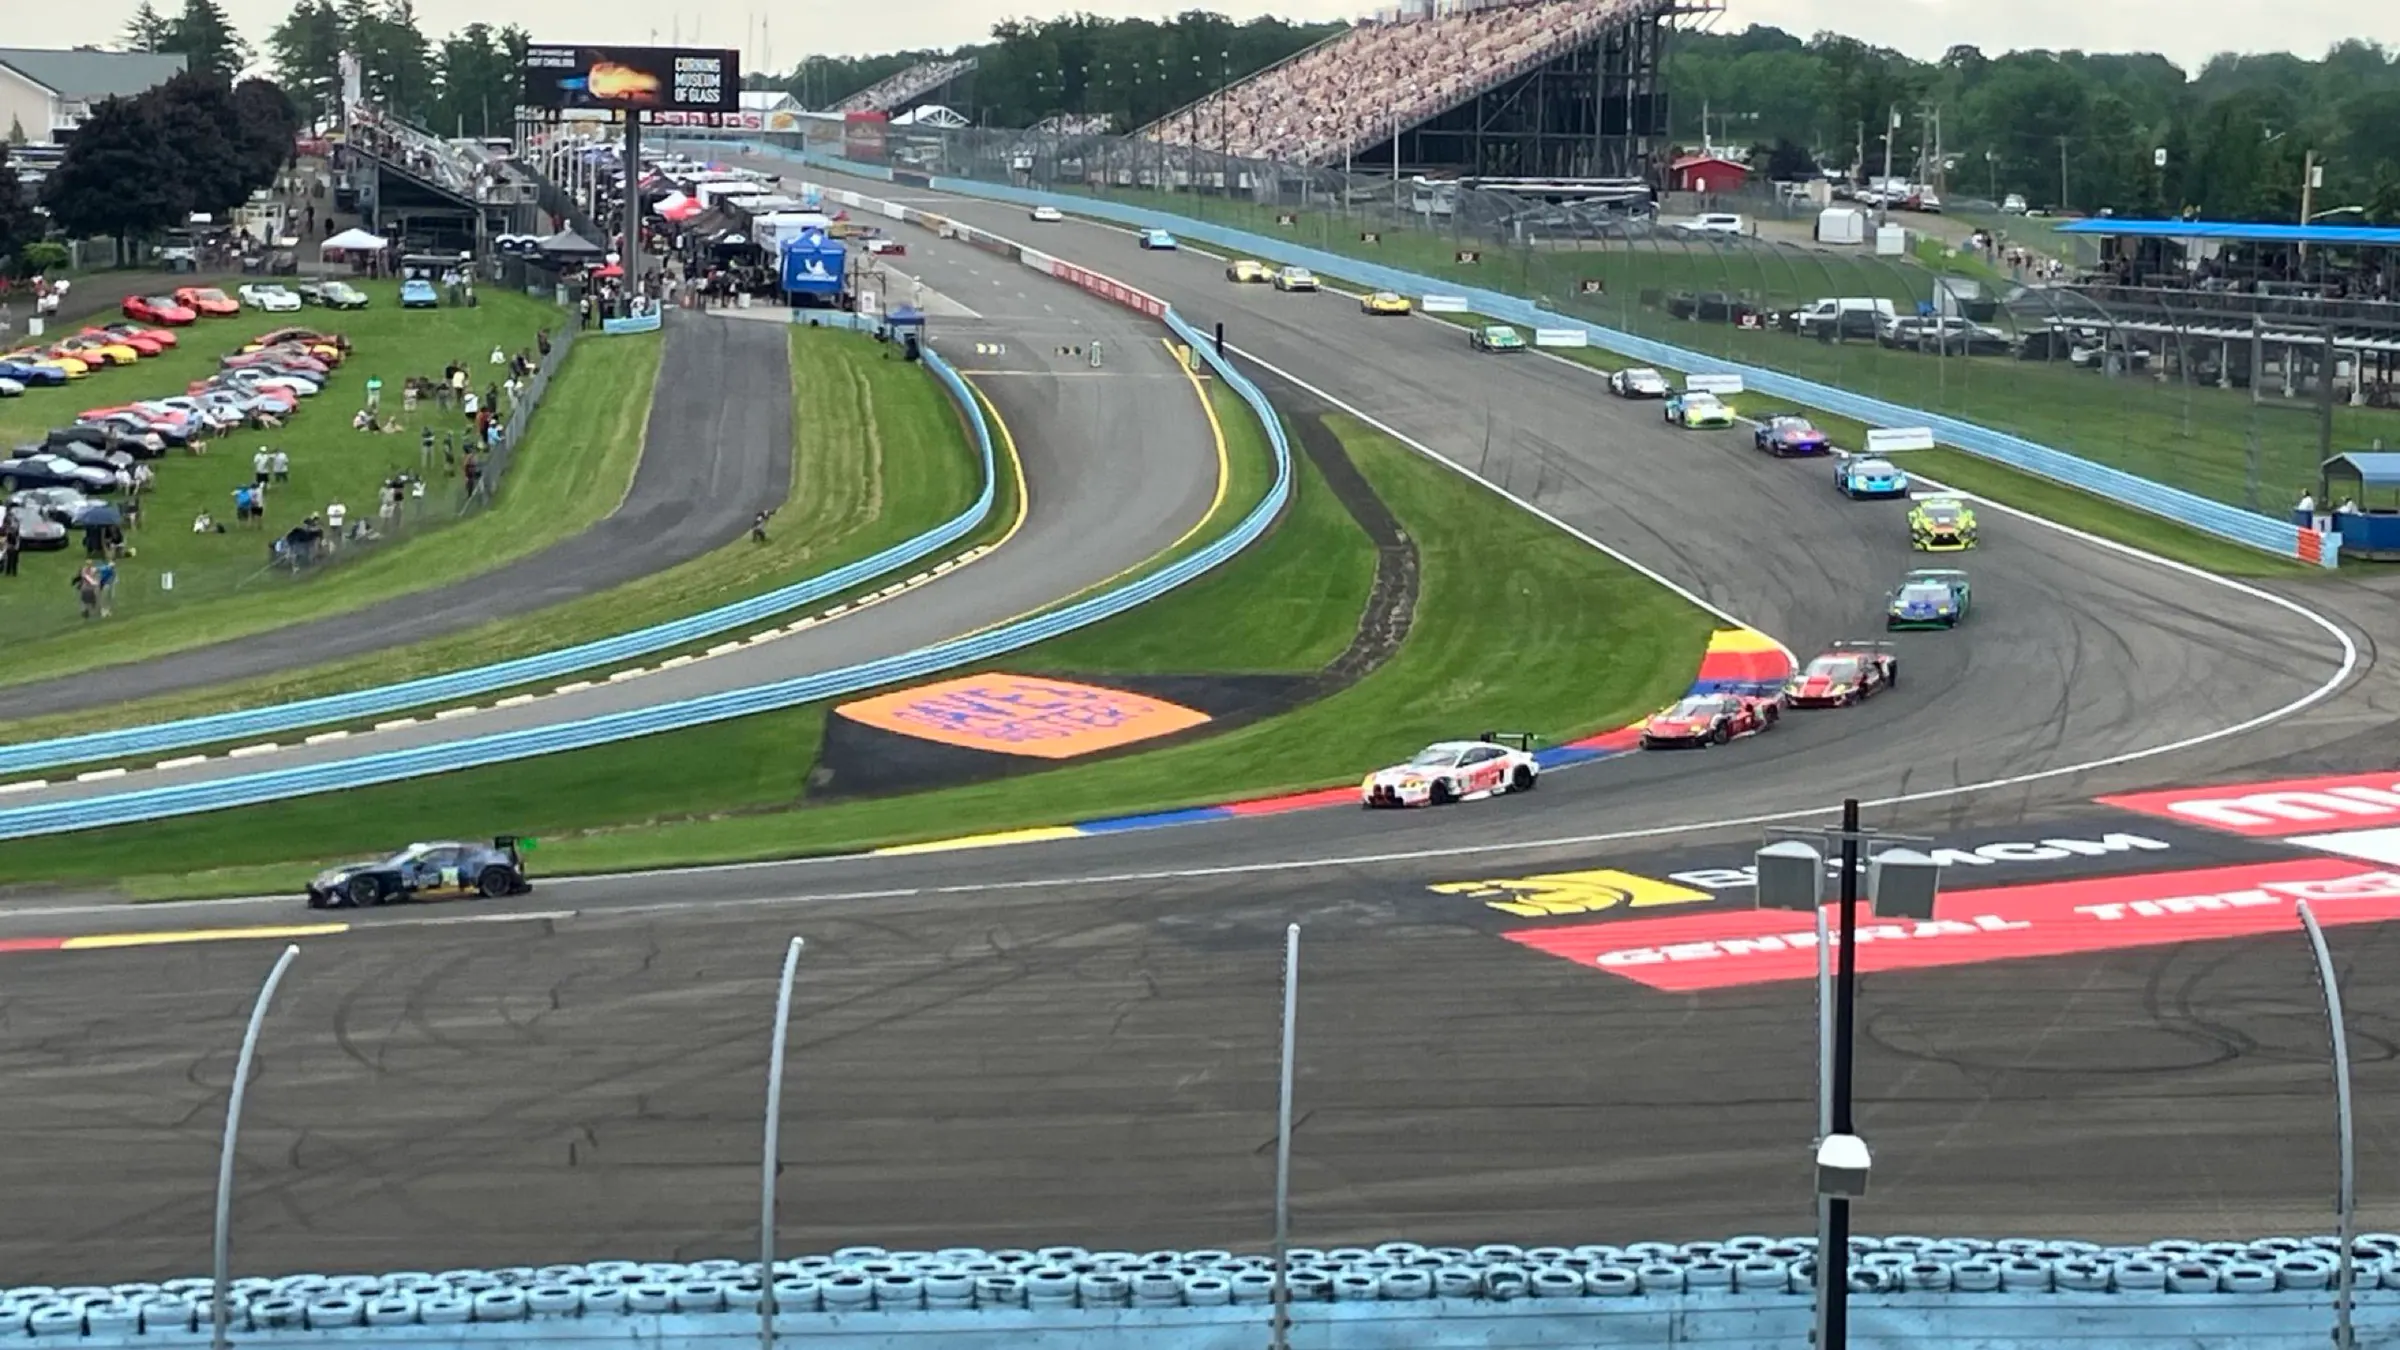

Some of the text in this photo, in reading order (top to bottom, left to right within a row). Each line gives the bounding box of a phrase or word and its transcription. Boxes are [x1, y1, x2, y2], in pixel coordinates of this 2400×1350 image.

[675, 73, 720, 87] MUSEUM
[675, 88, 720, 103] OF GLASS
[1596, 889, 2281, 966] GENERAL TIRE
